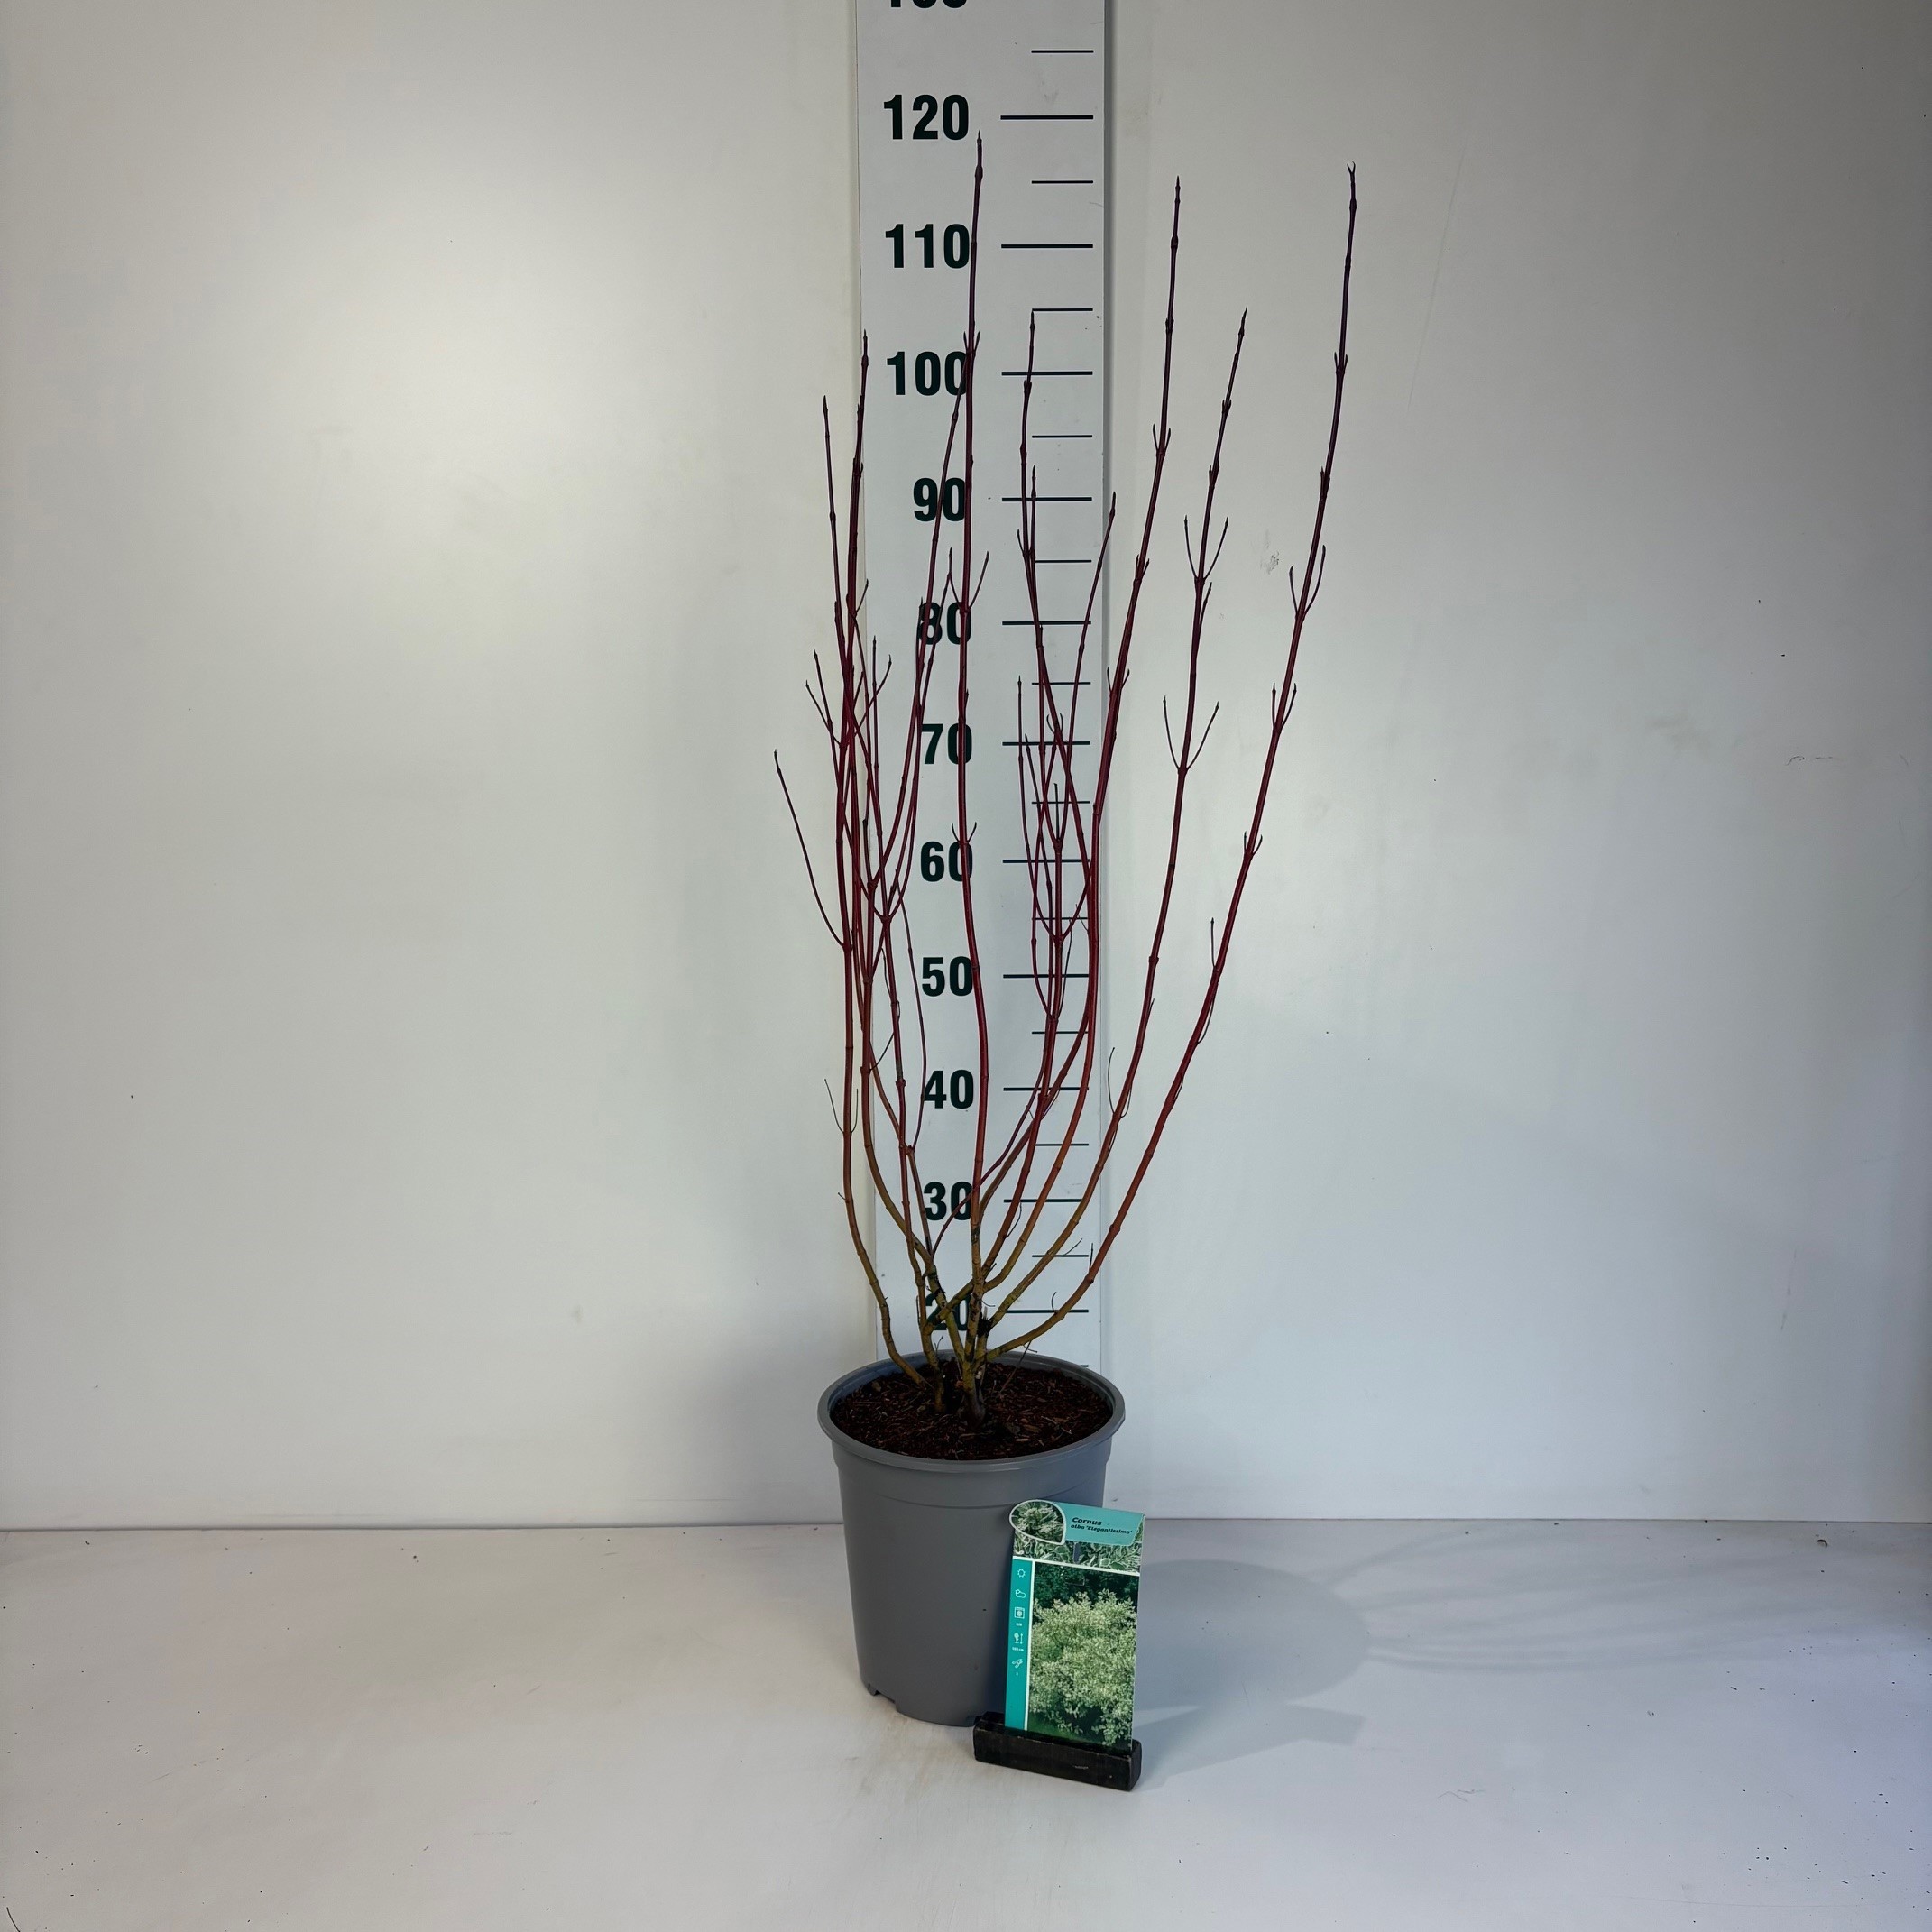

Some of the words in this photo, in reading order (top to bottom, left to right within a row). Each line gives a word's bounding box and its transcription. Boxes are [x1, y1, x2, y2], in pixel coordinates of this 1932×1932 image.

[883, 94, 969, 141] 120
[885, 223, 970, 269] 110
[887, 351, 970, 396] 100
[913, 477, 968, 522] 90
[917, 601, 972, 645] 80
[921, 722, 972, 765] 70
[920, 841, 973, 882] 60
[922, 956, 974, 997] 50
[924, 1069, 974, 1109] 40
[924, 1181, 974, 1221] 30
[1072, 1516, 1102, 1526] Cornus
